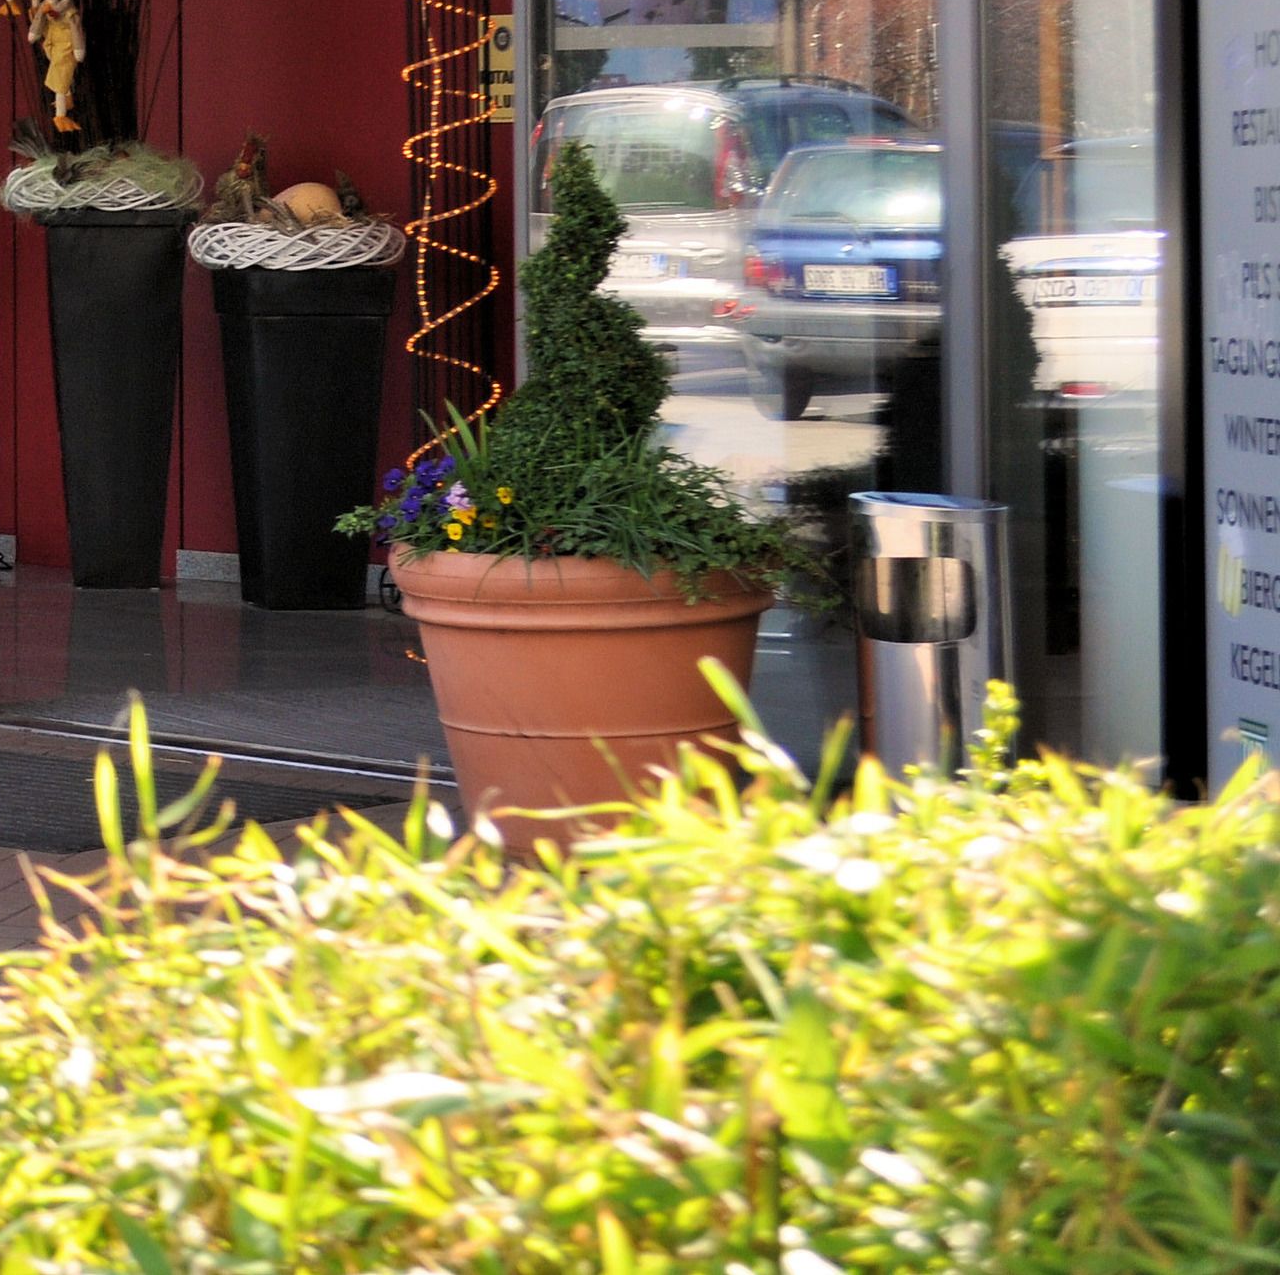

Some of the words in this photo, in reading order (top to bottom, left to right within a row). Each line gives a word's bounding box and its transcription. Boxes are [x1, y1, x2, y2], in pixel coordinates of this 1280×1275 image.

[1231, 105, 1280, 149] RESTA
[1241, 260, 1272, 301] PILS
[1230, 641, 1280, 691] KEGEL
